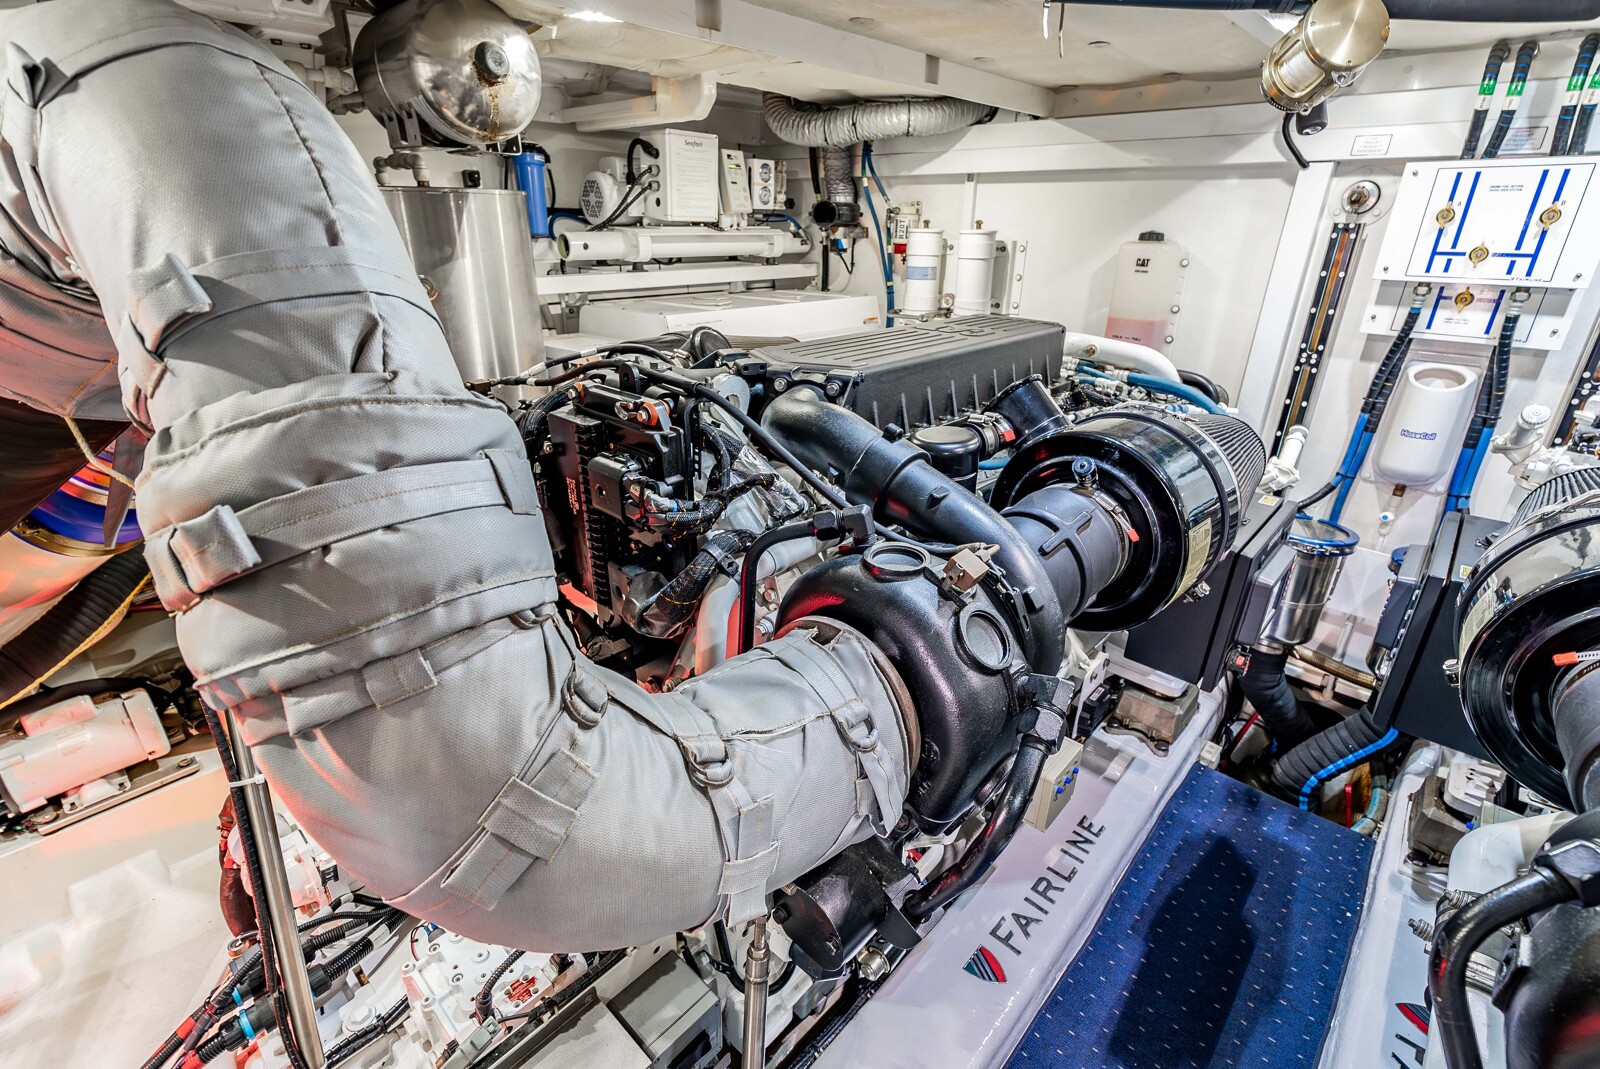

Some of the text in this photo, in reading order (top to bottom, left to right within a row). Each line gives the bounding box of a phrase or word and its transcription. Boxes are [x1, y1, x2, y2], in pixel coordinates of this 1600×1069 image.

[1135, 257, 1151, 268] CAT
[1400, 428, 1437, 441] HoseCoil
[988, 814, 1106, 957] FAIRLINE
